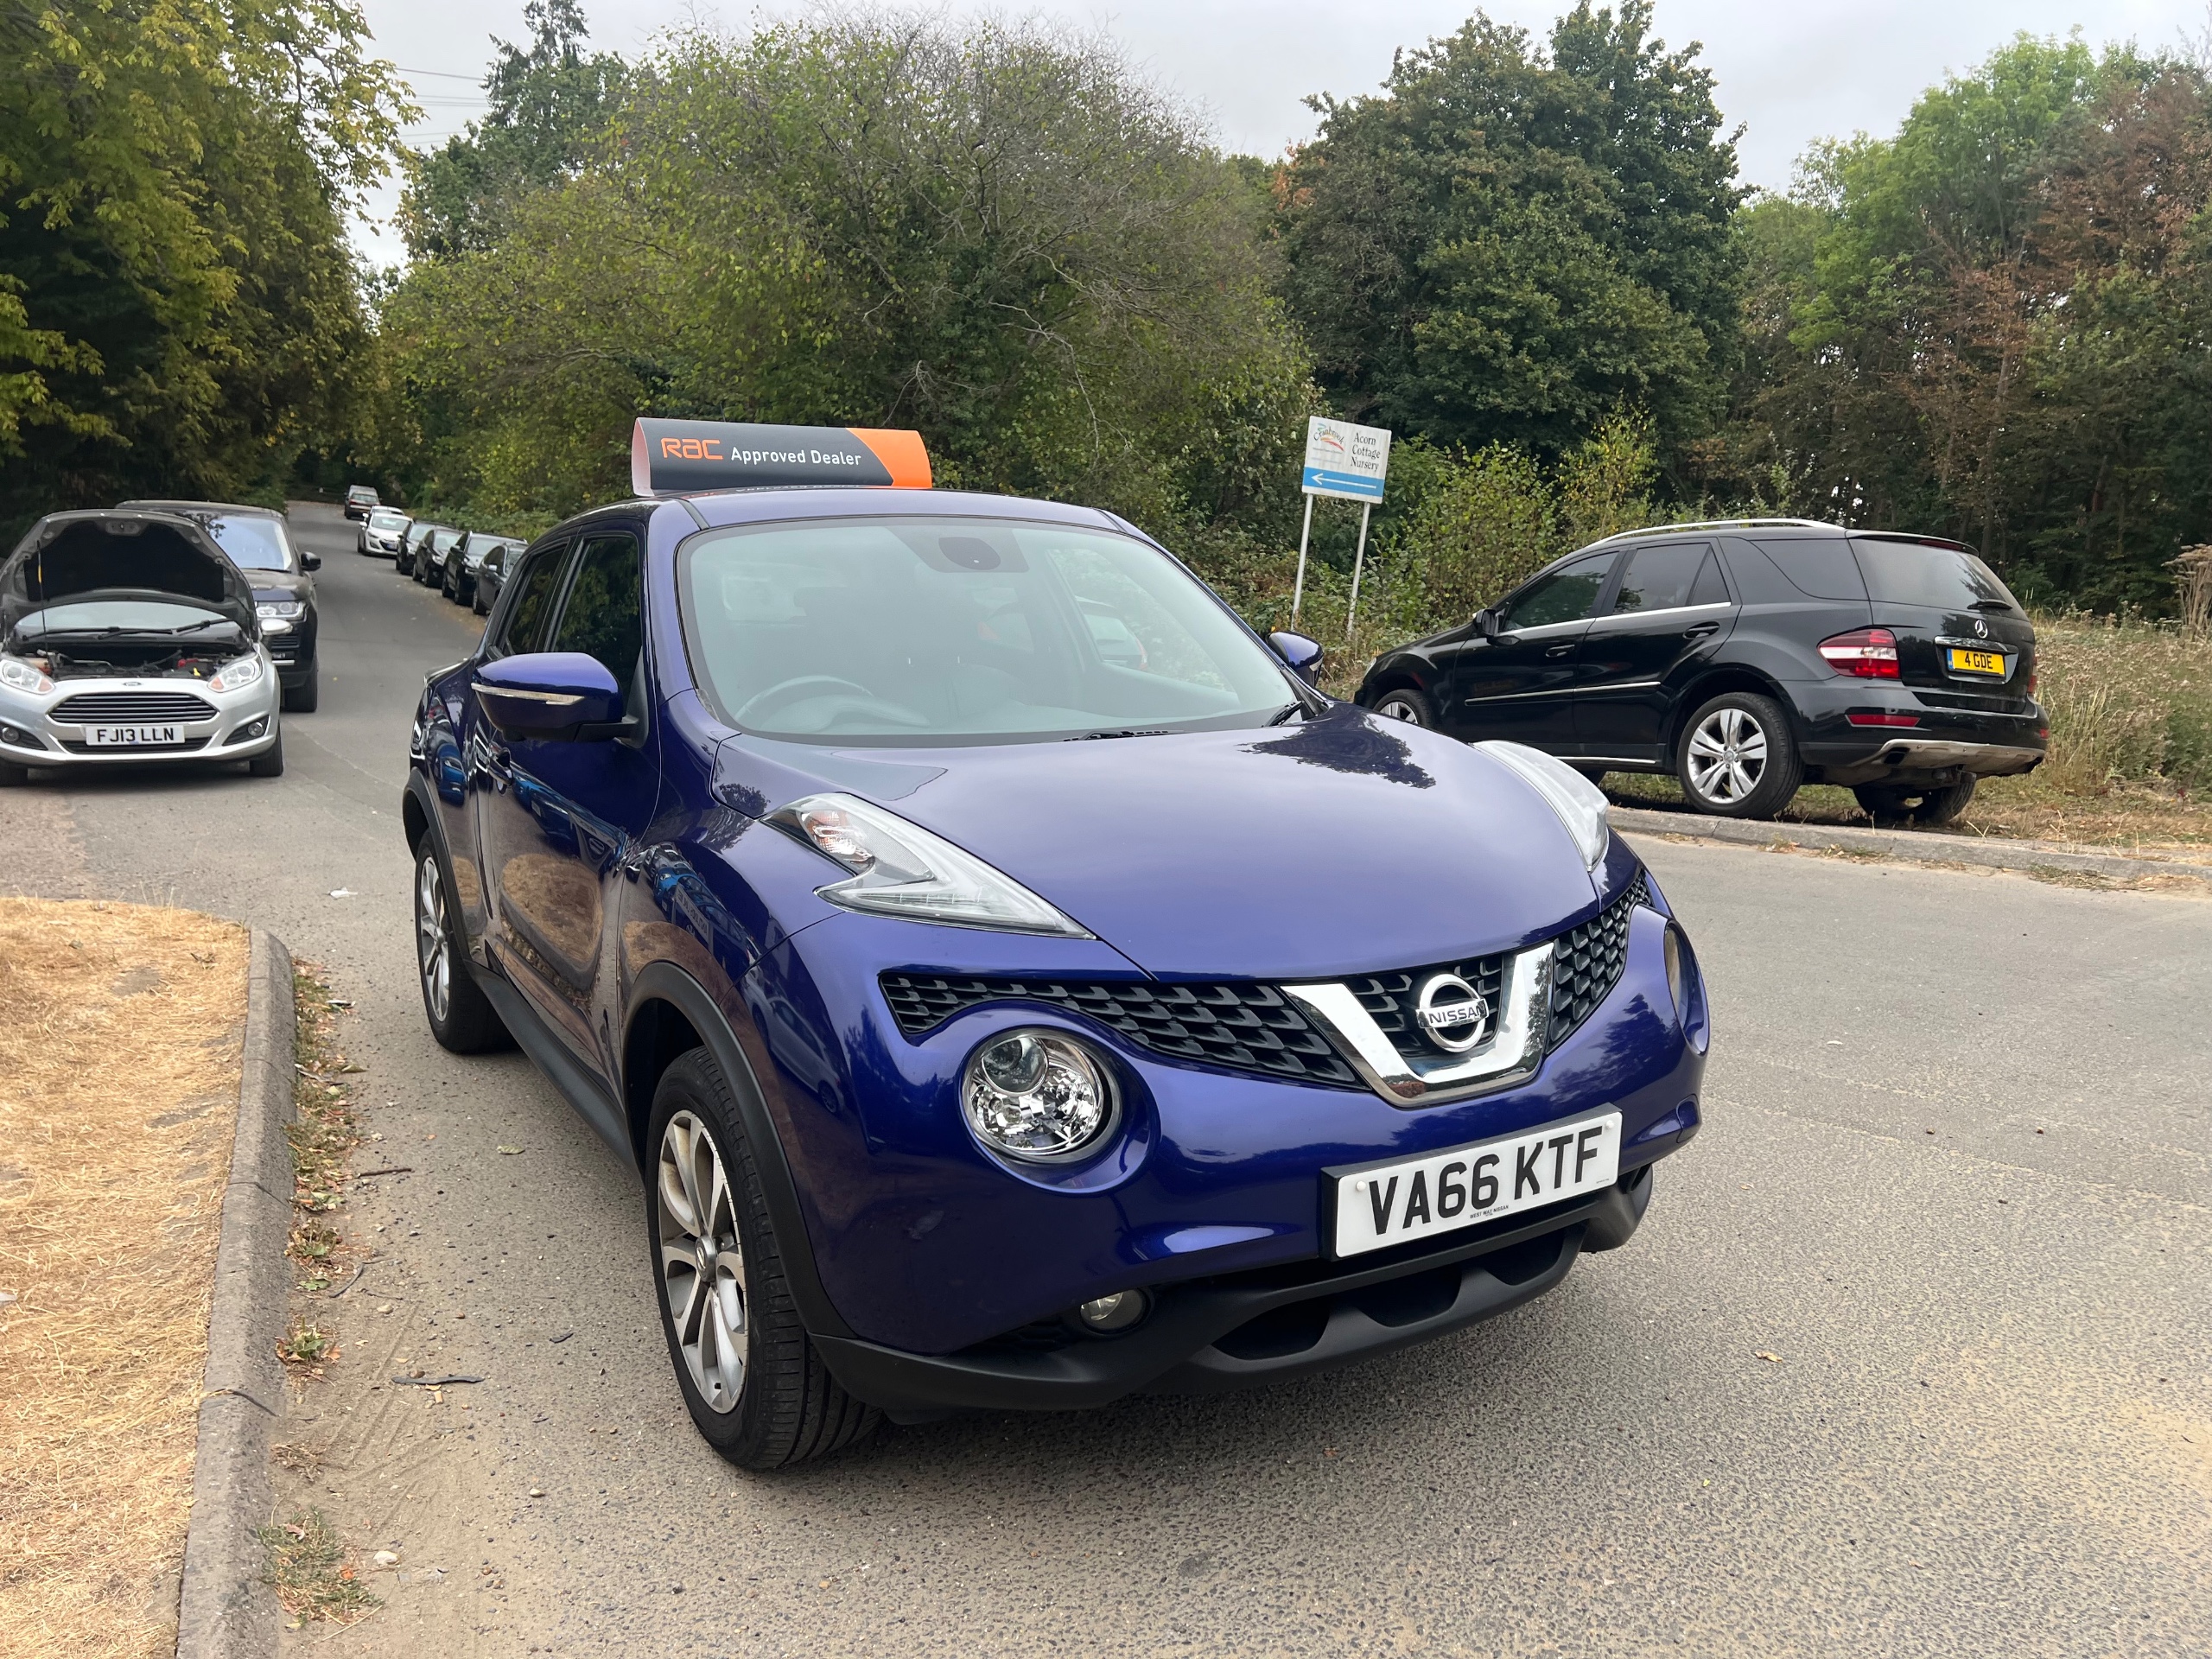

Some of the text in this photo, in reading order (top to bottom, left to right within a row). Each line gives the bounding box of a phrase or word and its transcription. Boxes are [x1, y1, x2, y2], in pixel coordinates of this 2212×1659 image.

[1353, 432, 1376, 446] Acorn
[731, 447, 806, 465] Approved
[810, 449, 861, 465] Dealer
[1351, 444, 1381, 460] Cottage
[1351, 456, 1379, 472] Nursery
[1964, 652, 1993, 670] 4 GDE
[97, 728, 175, 742] FJ13 LLN
[1428, 1003, 1485, 1024] NISSAN
[1369, 1126, 1603, 1236] VA66 KTF
